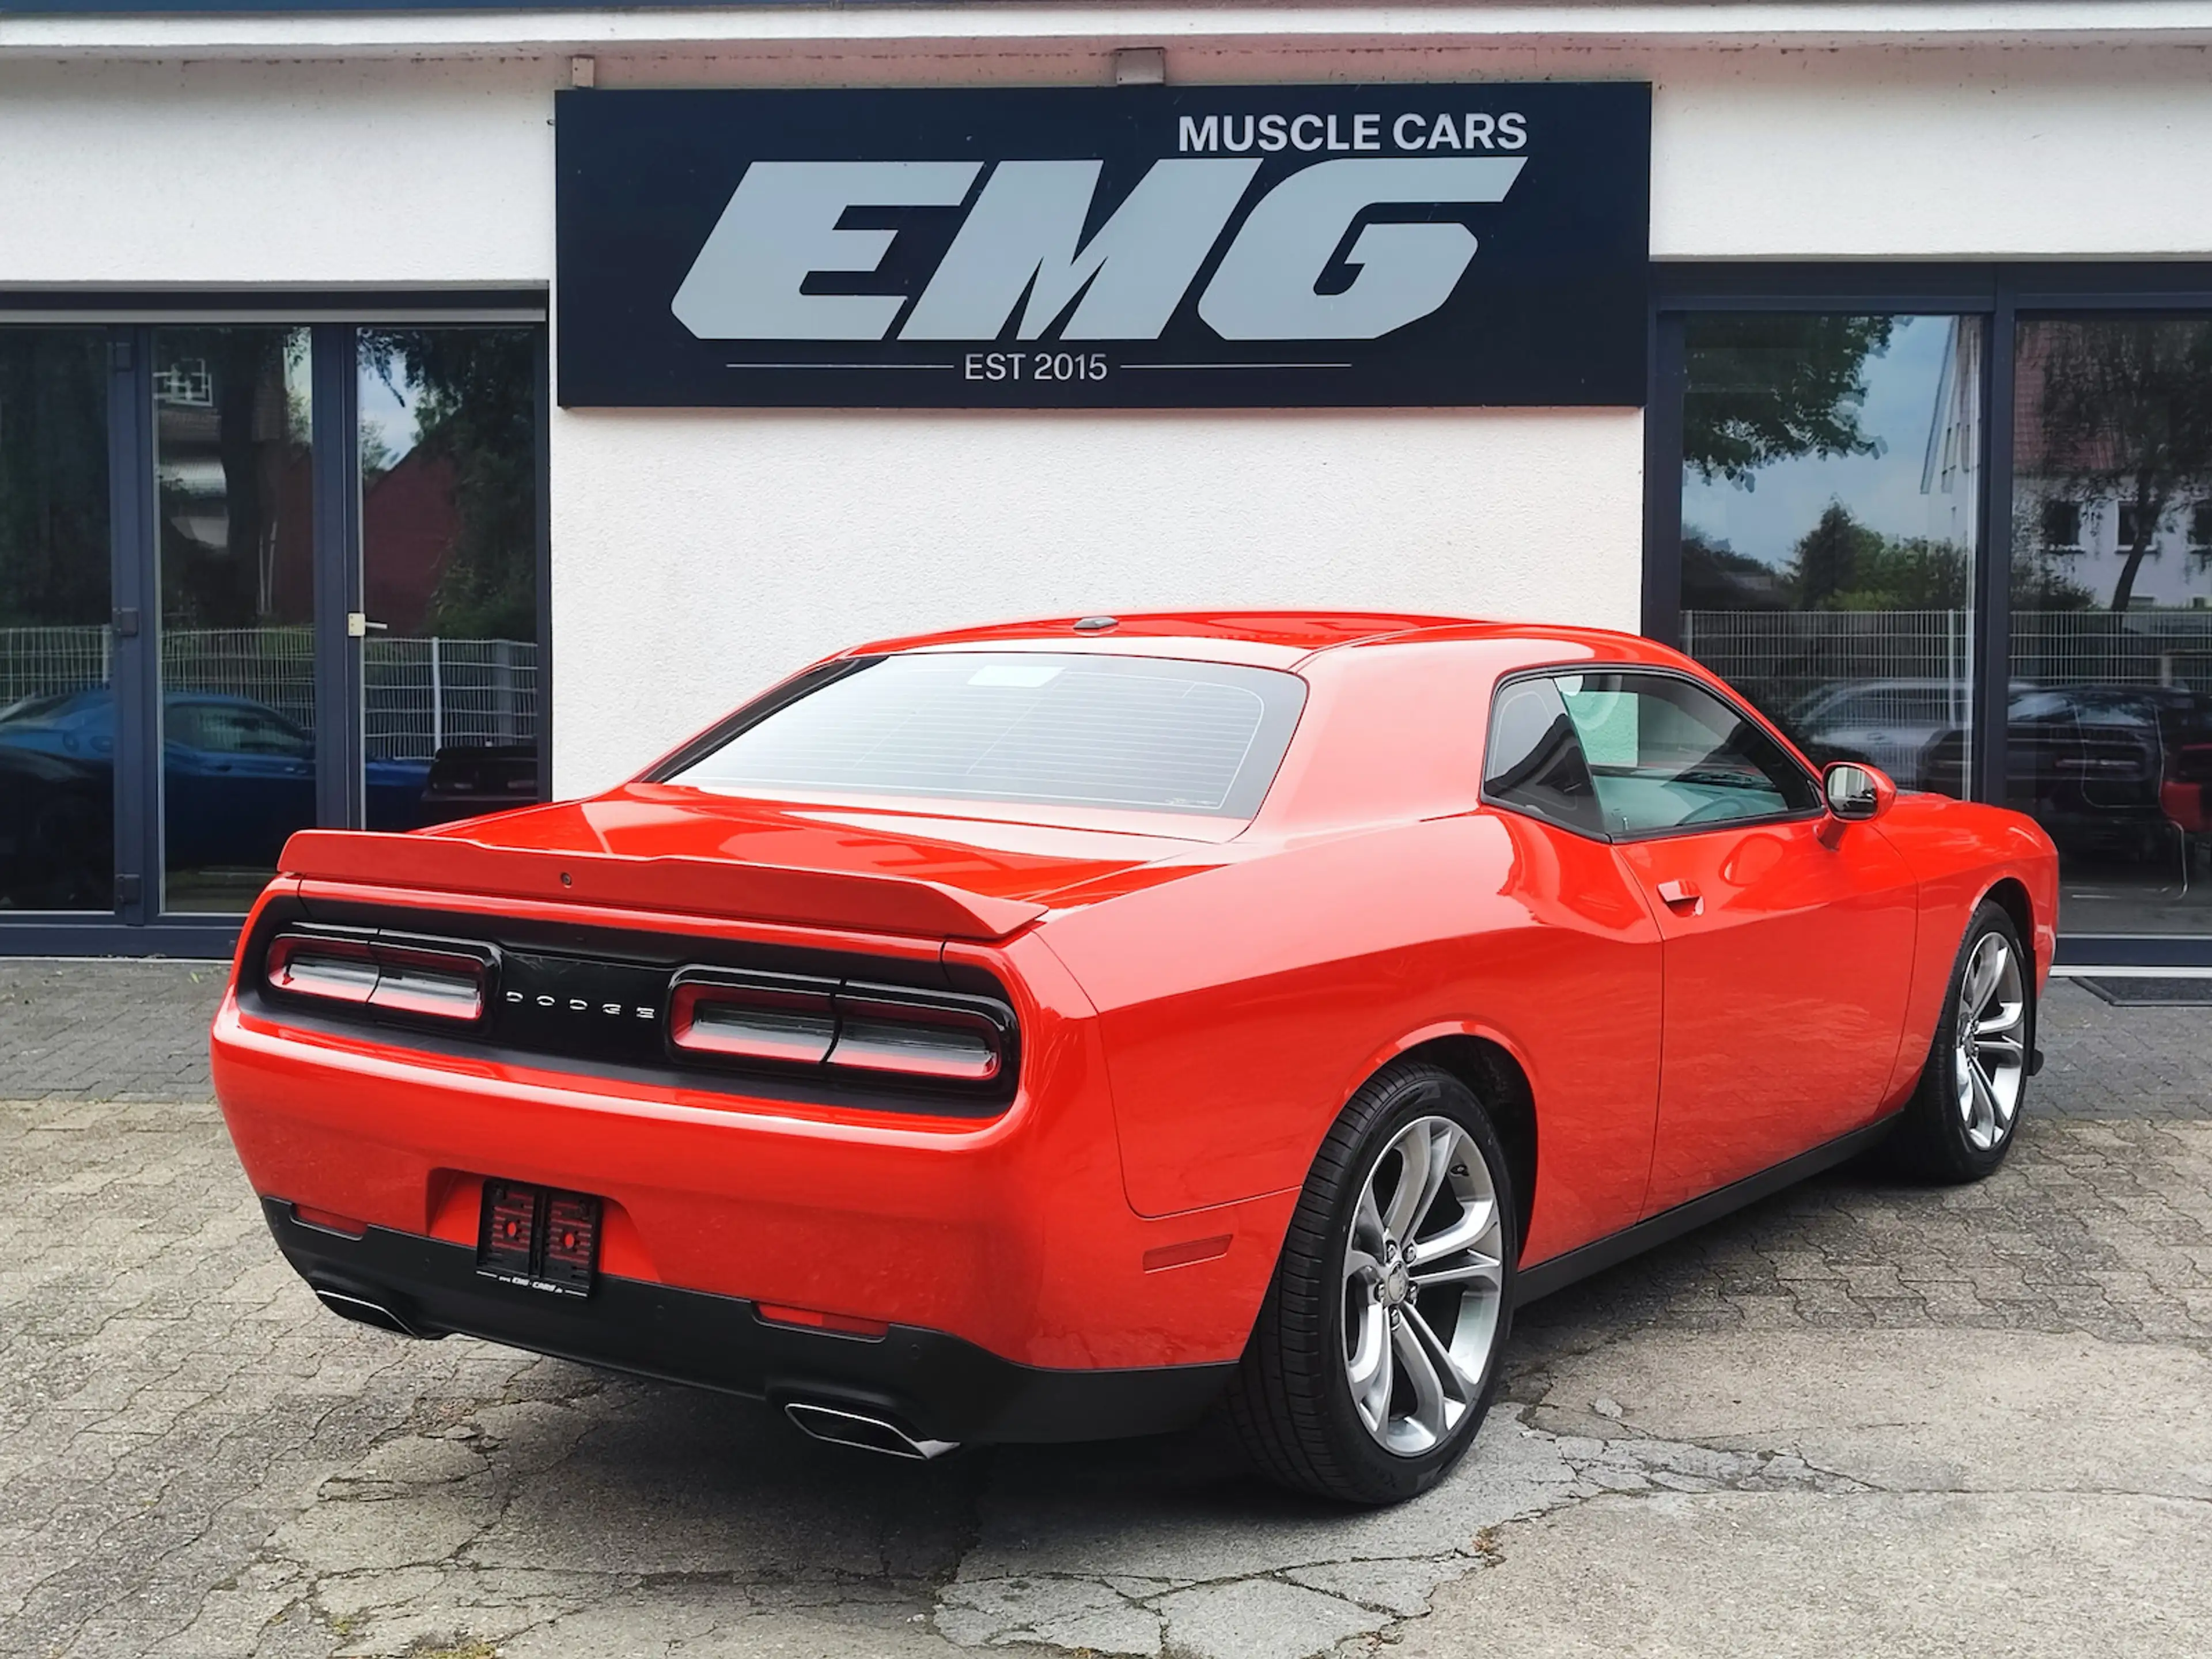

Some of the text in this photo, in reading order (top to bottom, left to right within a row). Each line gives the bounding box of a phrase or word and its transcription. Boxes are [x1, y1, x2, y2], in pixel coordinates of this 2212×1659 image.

[1179, 112, 1527, 151] MUSCLE CARS
[672, 156, 1528, 342] EMG
[964, 353, 1108, 380] EST 2015
[505, 990, 656, 1018] DODGE
